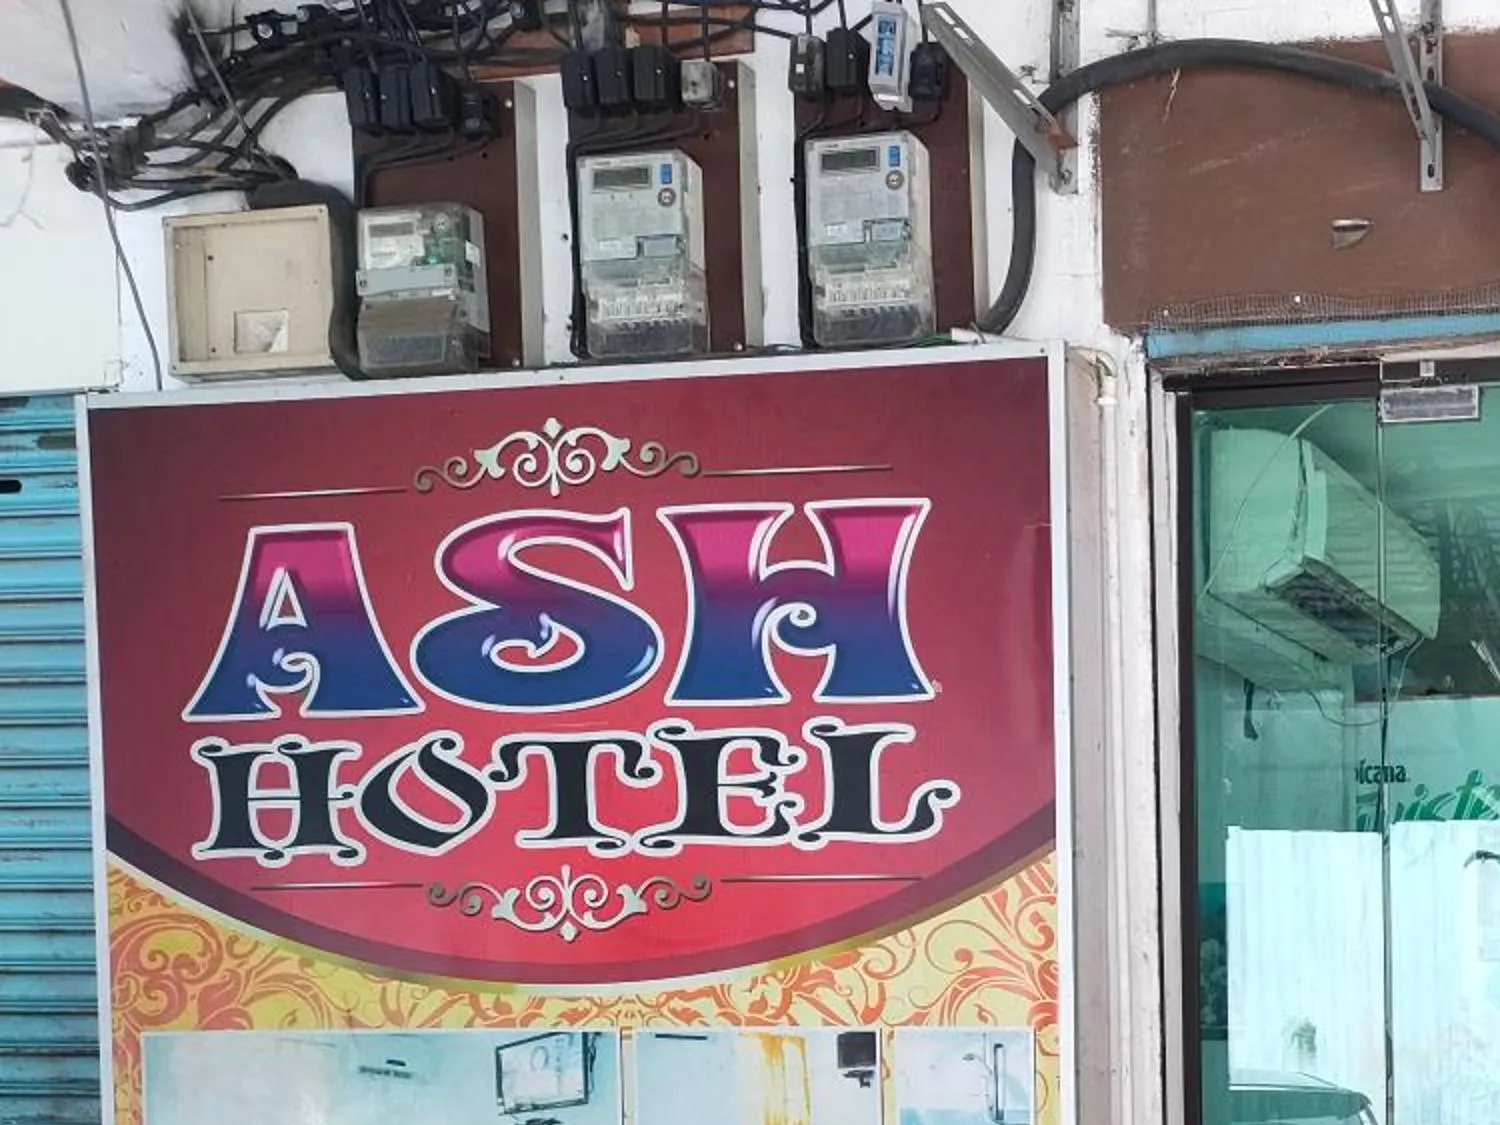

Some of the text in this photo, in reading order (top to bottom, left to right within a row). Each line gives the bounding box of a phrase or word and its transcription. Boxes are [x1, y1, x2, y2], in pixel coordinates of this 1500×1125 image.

[183, 497, 937, 721] ASH
[191, 717, 960, 864] HOTEL
[1355, 758, 1407, 785] icana
